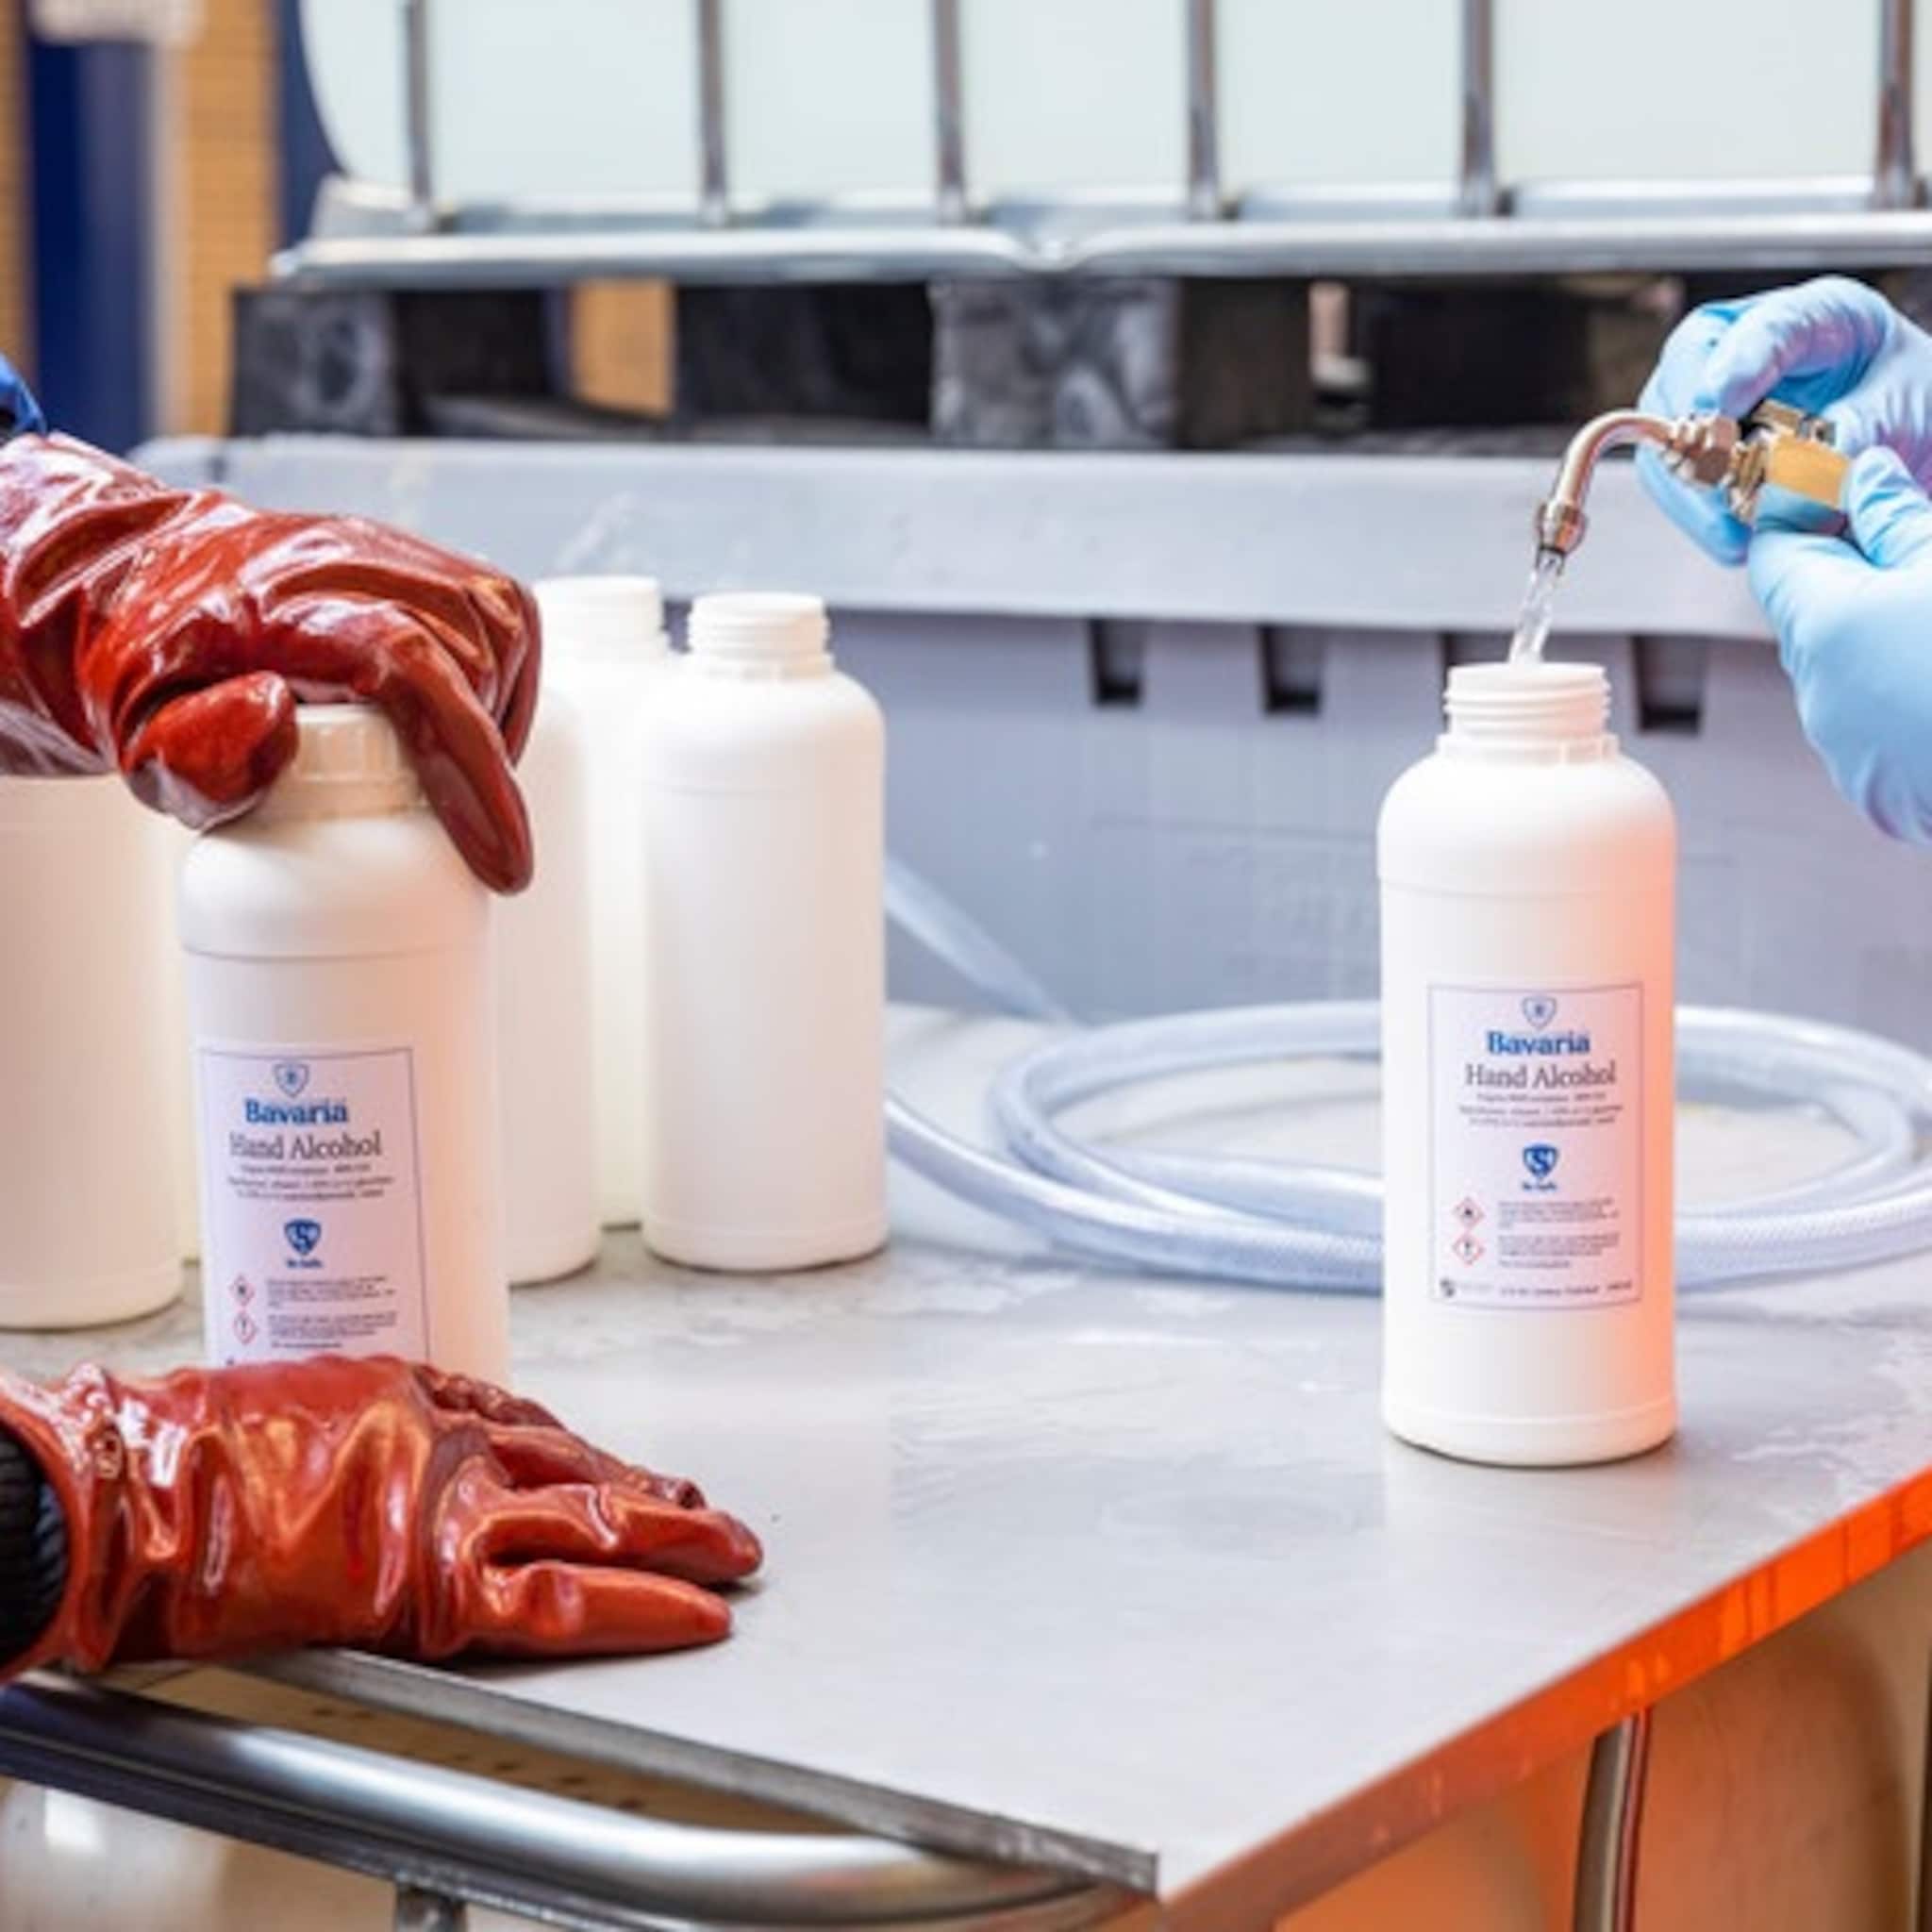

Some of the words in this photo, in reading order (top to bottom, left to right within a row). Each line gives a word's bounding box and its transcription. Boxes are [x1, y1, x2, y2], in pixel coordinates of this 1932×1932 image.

[1487, 1030, 1591, 1055] Bavaria
[1465, 1064, 1527, 1088] Hand
[1532, 1060, 1617, 1089] Alcohol
[244, 1096, 349, 1123] Bavaria
[229, 1132, 284, 1158] Hand
[290, 1129, 382, 1159] Alcohol
